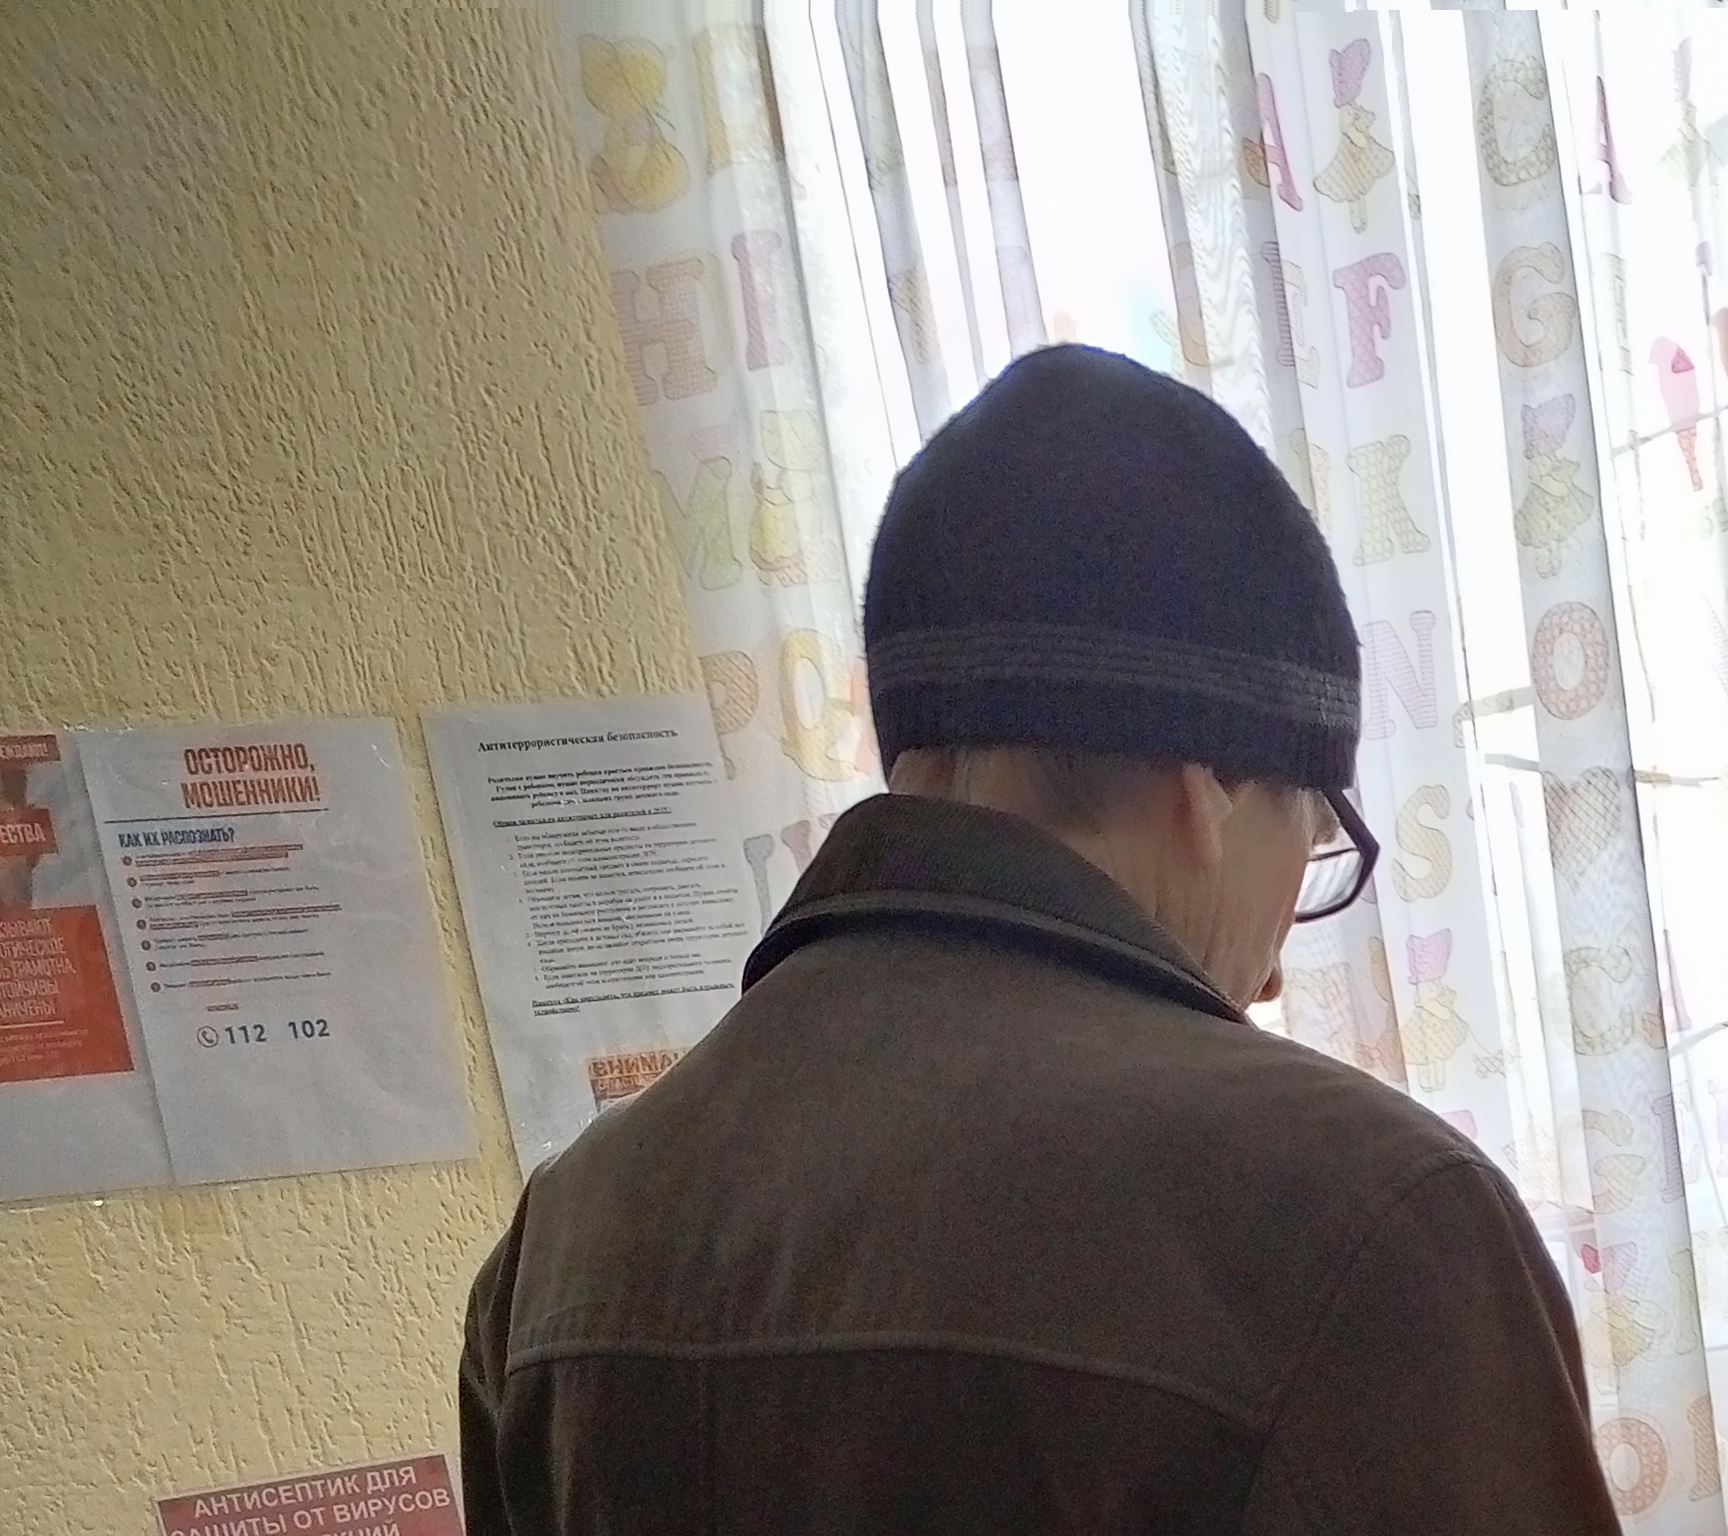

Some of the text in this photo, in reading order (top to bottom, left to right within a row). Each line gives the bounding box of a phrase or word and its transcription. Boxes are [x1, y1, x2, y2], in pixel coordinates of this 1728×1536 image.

[478, 728, 679, 753] Антитеррористическая безопасность
[184, 743, 316, 776] ОСТОРОЖНО,
[181, 776, 321, 809] МОШЕННИКИ!
[118, 827, 235, 848] КАК ИХ РАСПОЗНАТЬ?
[225, 1018, 331, 1044] 112 102
[193, 1465, 417, 1518] АНТИСЕПТИК ДЛЯ
[293, 1507, 327, 1531] ОТ
[335, 1487, 451, 1523] ВИРУСОВ
